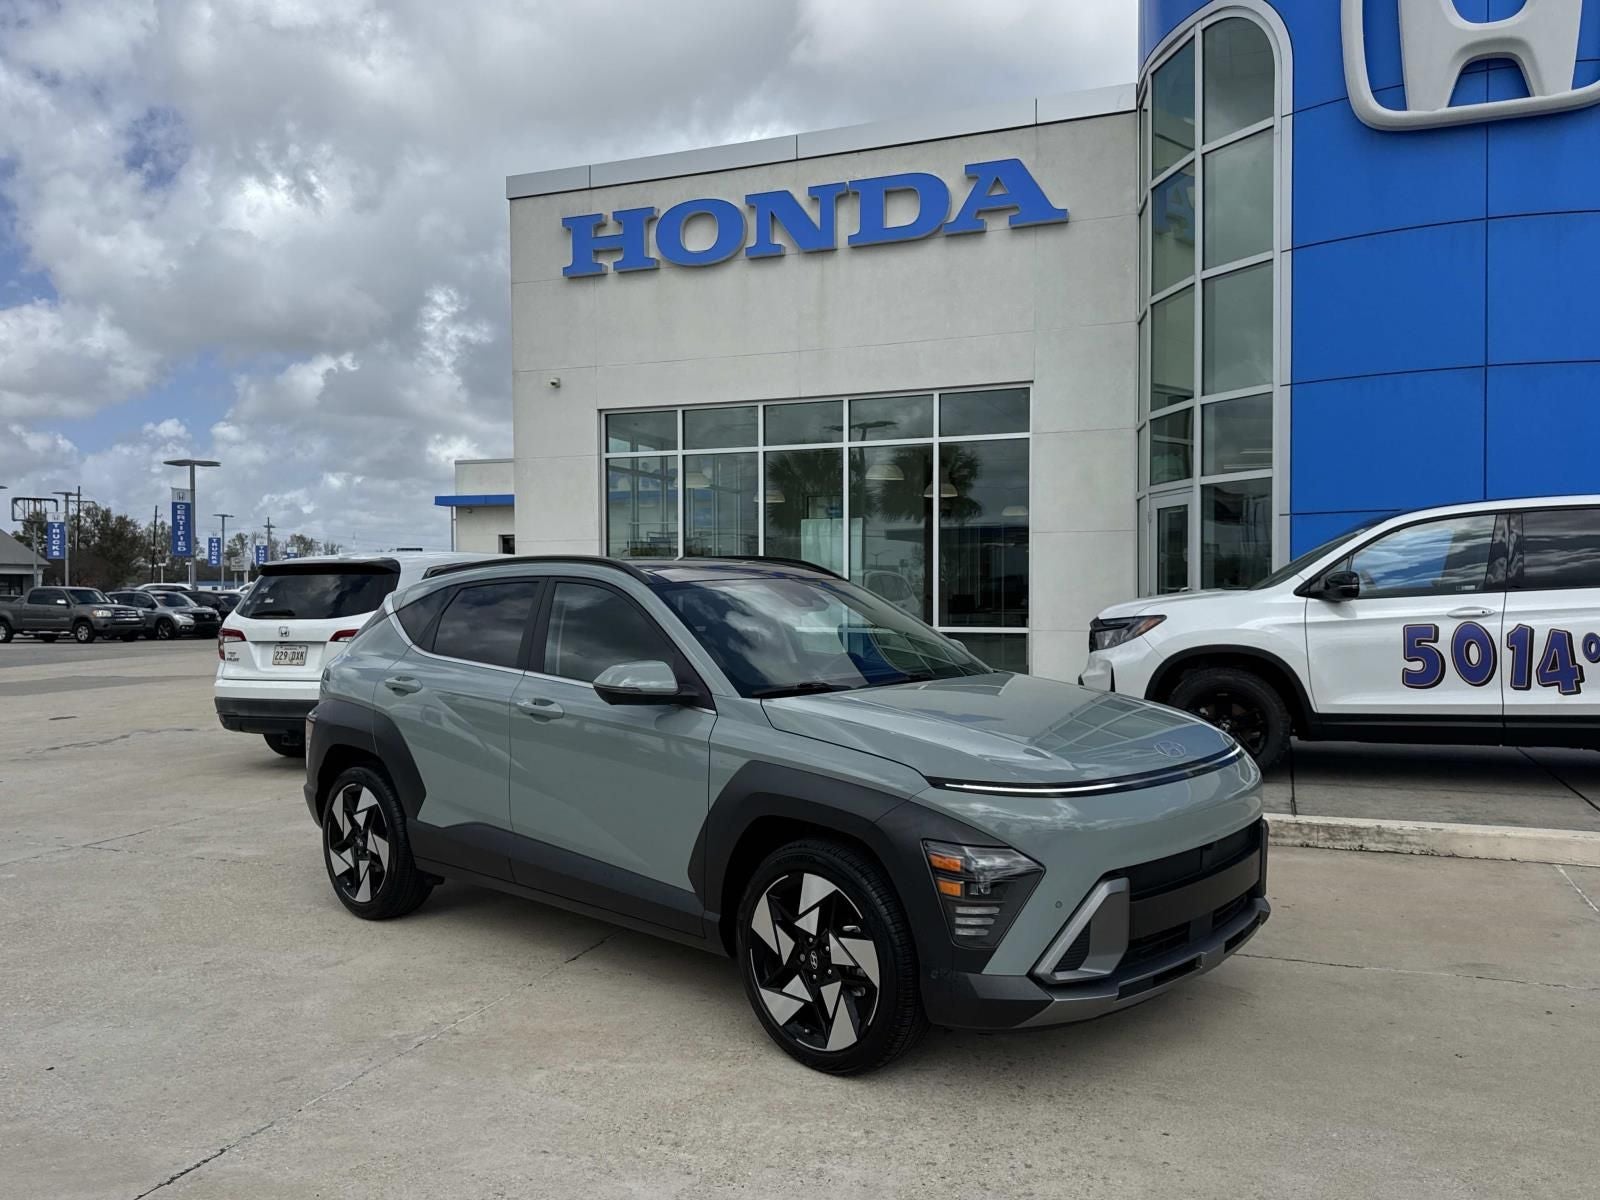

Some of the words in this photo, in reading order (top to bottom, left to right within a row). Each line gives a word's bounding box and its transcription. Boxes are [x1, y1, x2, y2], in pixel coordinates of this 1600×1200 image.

[562, 158, 1068, 277] HONDA
[52, 522, 60, 556] TRUCKS
[177, 504, 186, 551] CERTIFIED
[275, 650, 288, 661] 229
